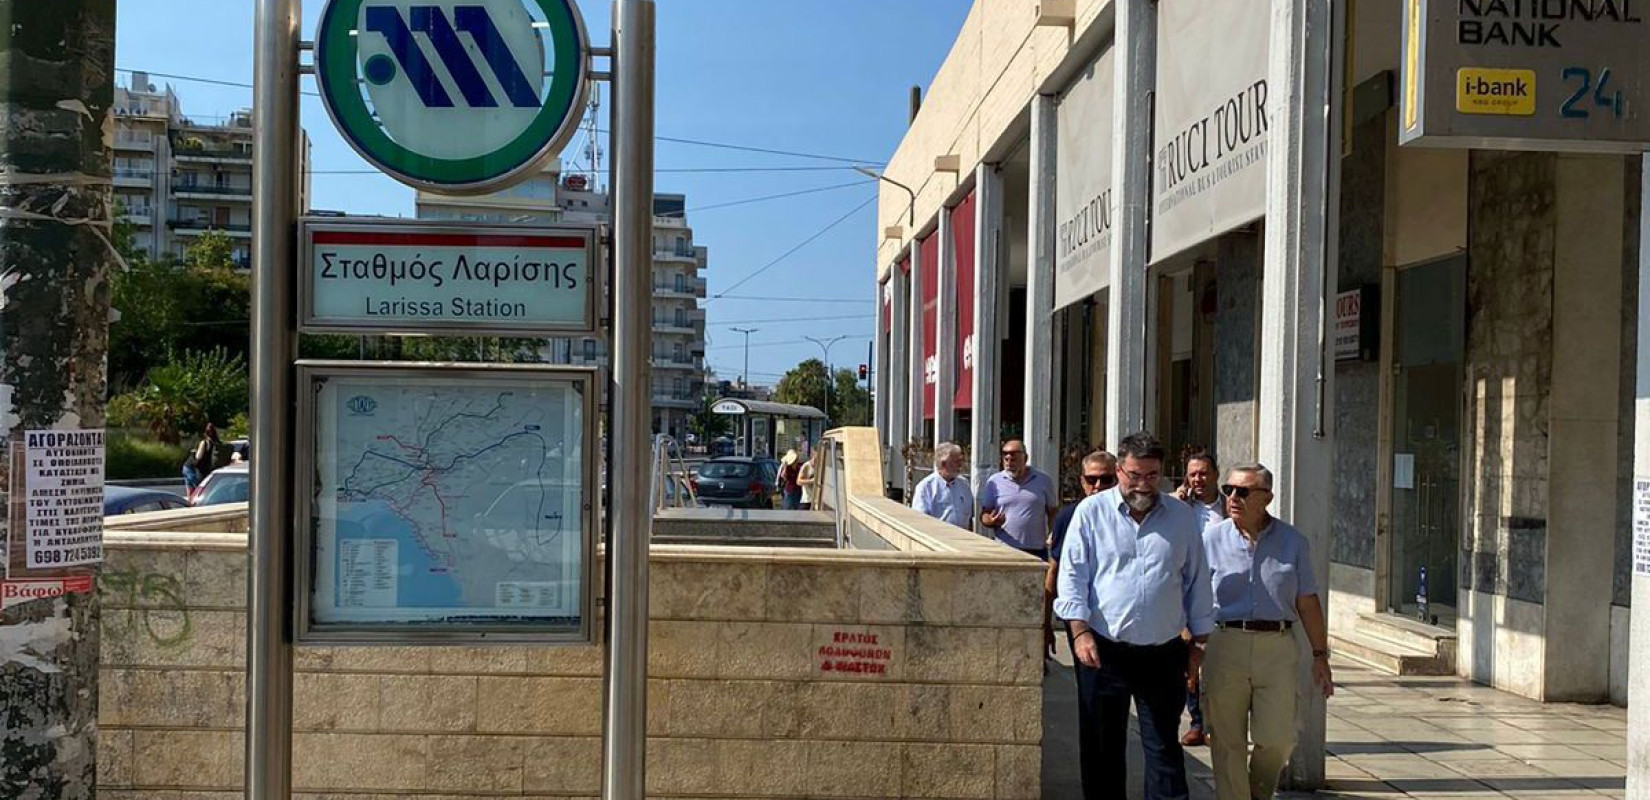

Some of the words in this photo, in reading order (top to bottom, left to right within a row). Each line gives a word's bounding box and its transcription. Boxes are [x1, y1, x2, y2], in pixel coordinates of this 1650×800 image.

[1459, 0, 1641, 22] NATIONAL
[1459, 20, 1561, 47] BANK
[1466, 76, 1527, 96] i-bank
[1560, 67, 1622, 118] 24
[1168, 117, 1209, 189] RUCI
[321, 252, 443, 287] Σταθμός
[452, 253, 577, 289] Λαρίσης
[366, 297, 443, 316] Larissa
[451, 297, 526, 317] Station
[35, 549, 61, 564] 698
[4, 584, 62, 598] Βάφω
